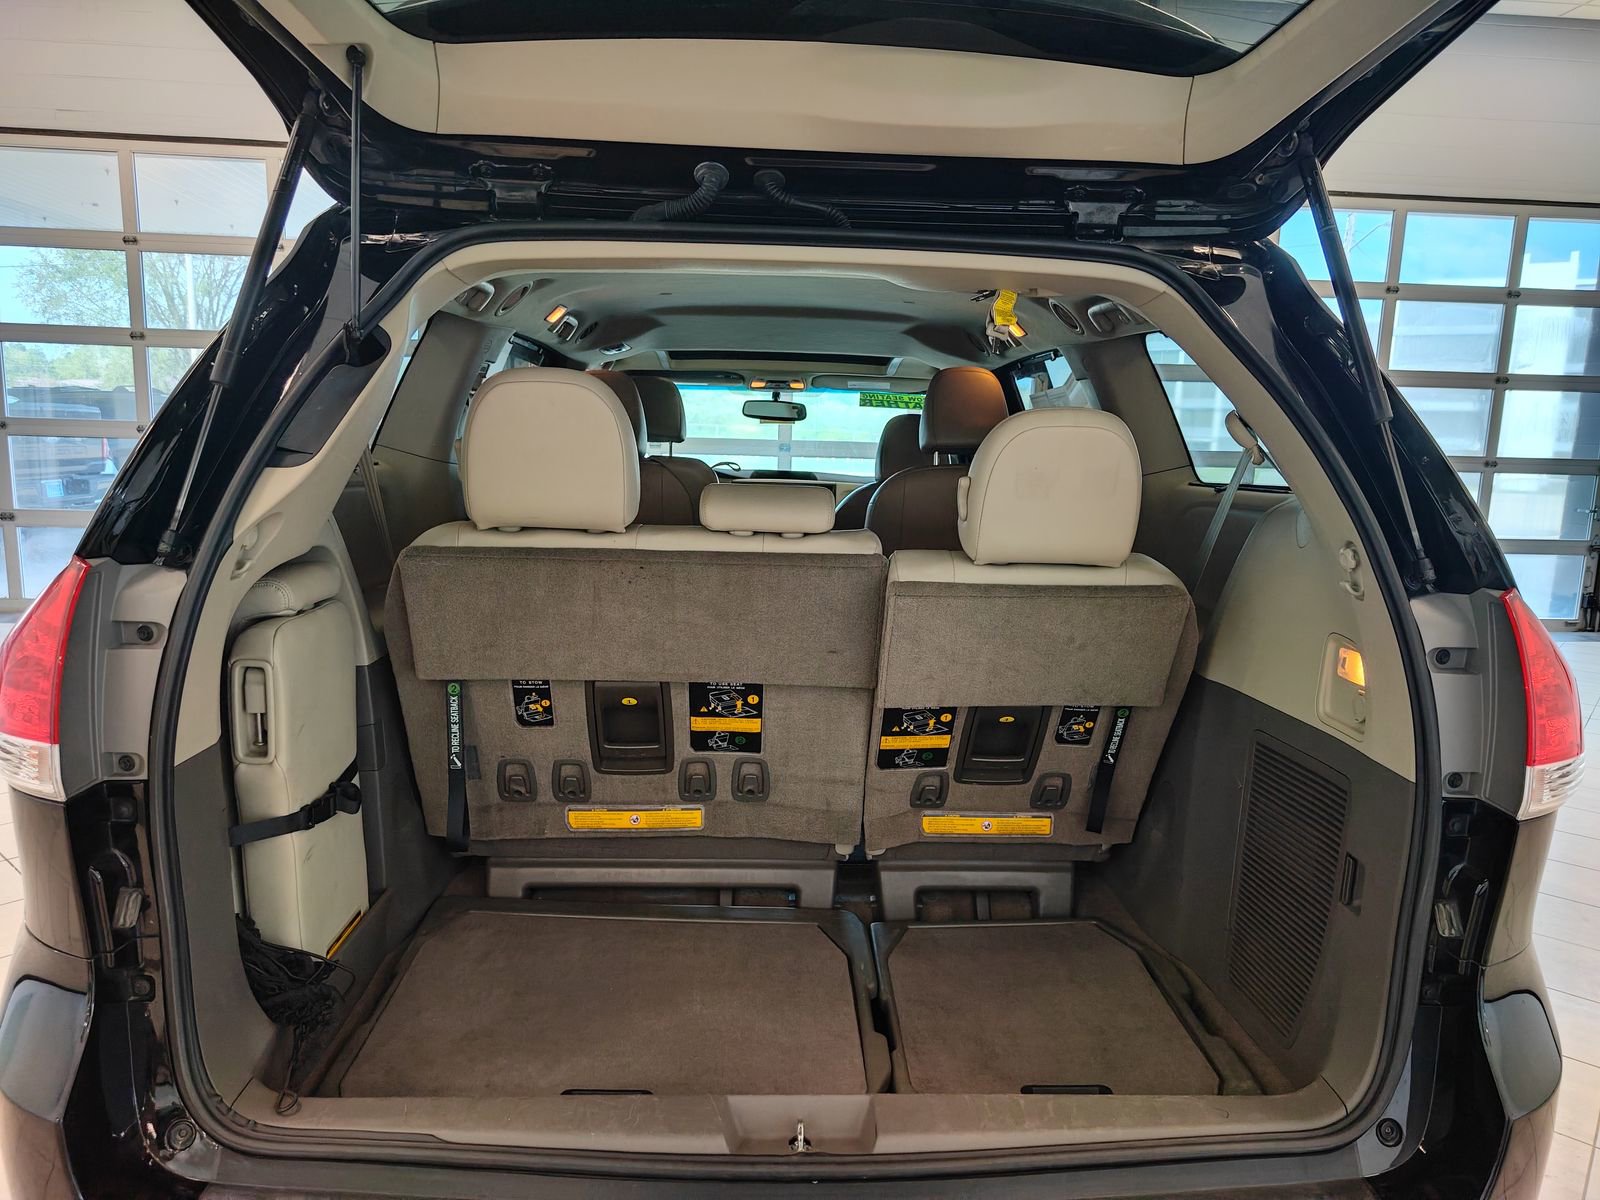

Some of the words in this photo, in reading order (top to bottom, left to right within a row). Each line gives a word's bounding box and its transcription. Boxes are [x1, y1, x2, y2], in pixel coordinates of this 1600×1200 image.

[449, 695, 459, 723] SEATBACK
[451, 723, 460, 746] RECLINE
[451, 745, 460, 754] TO
